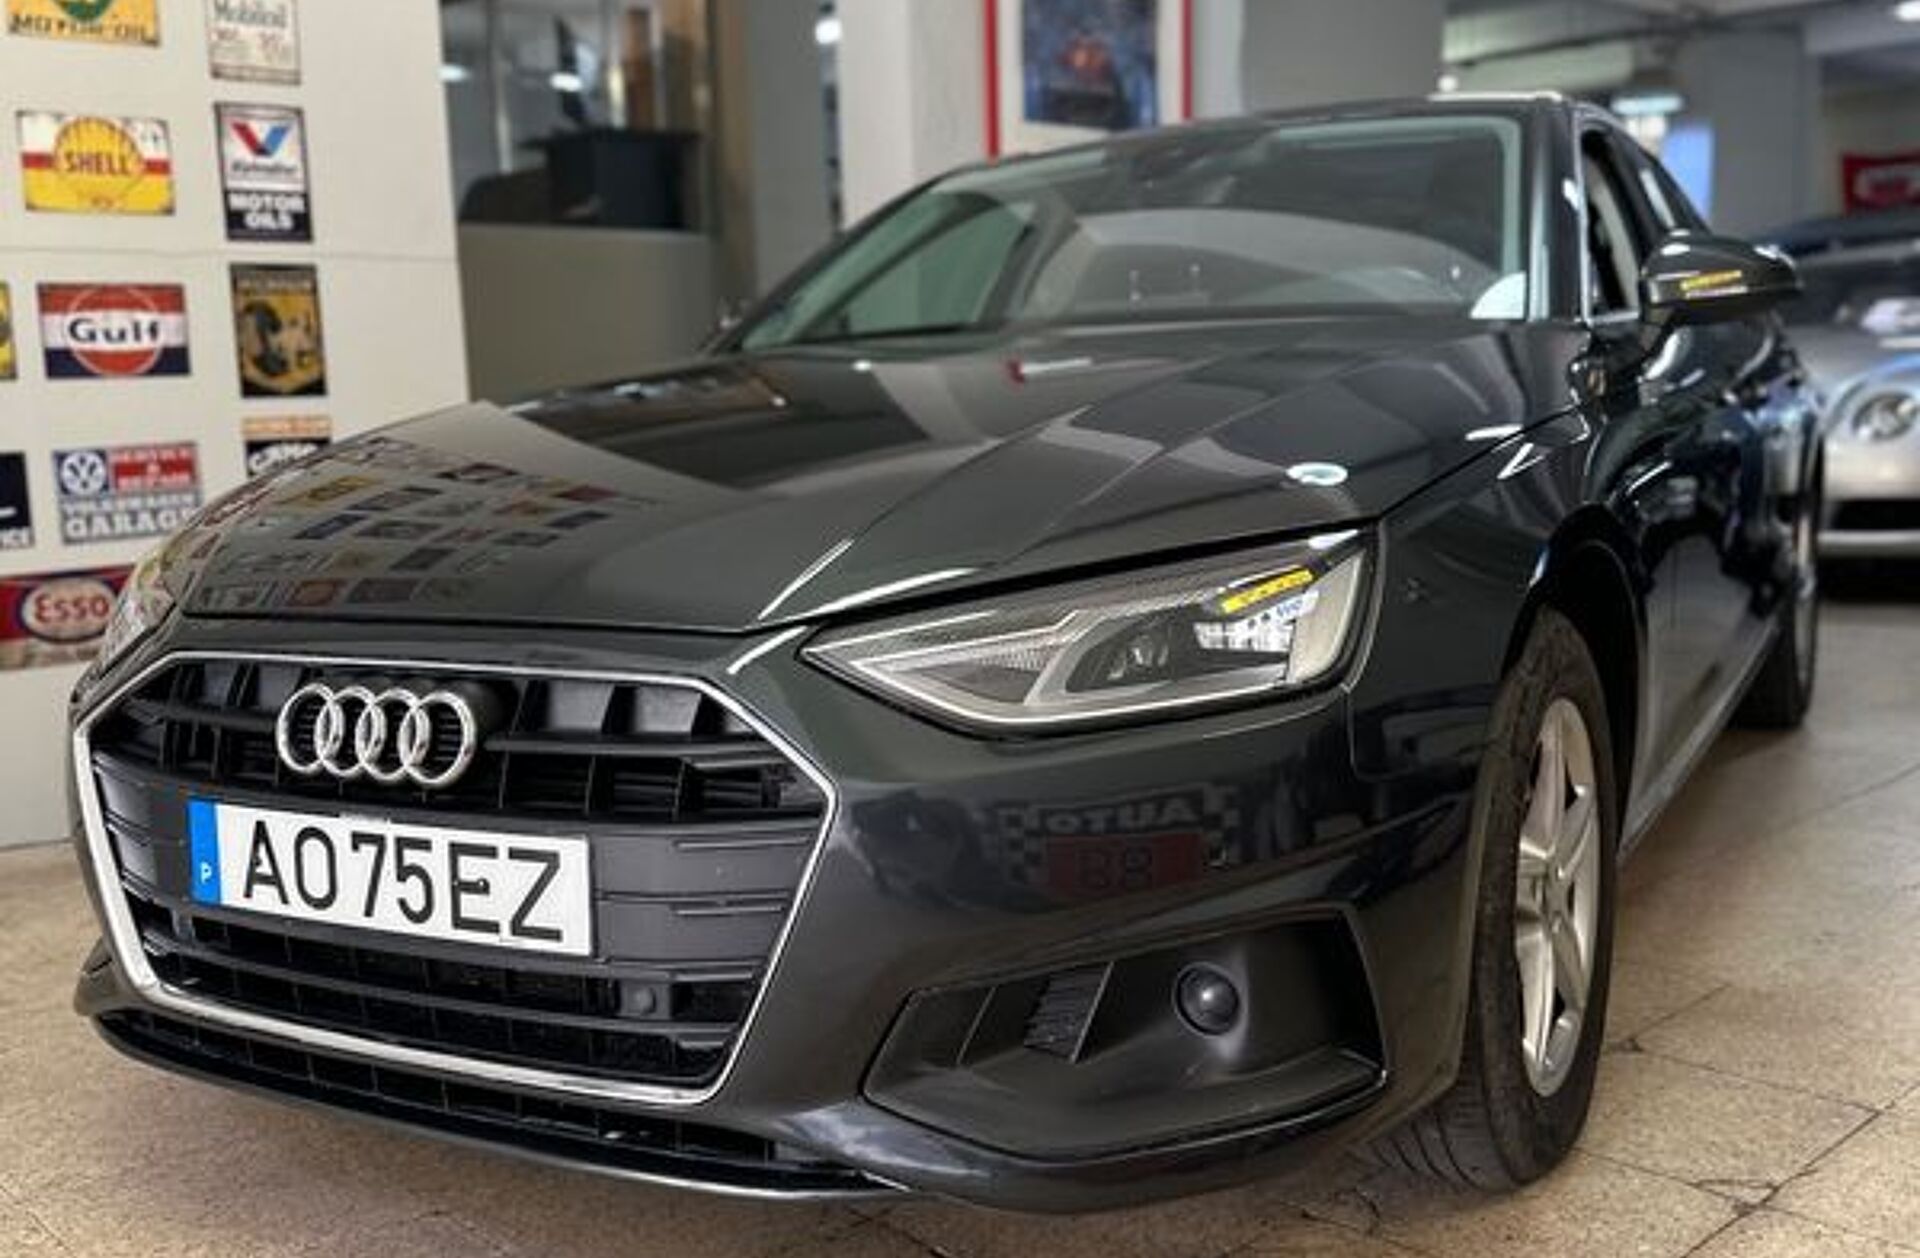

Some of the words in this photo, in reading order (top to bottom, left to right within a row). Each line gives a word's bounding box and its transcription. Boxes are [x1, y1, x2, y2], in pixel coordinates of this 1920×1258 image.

[64, 150, 130, 175] SHELL
[229, 192, 305, 214] MOTOR
[245, 211, 293, 231] OILS
[67, 317, 160, 343] Gulf
